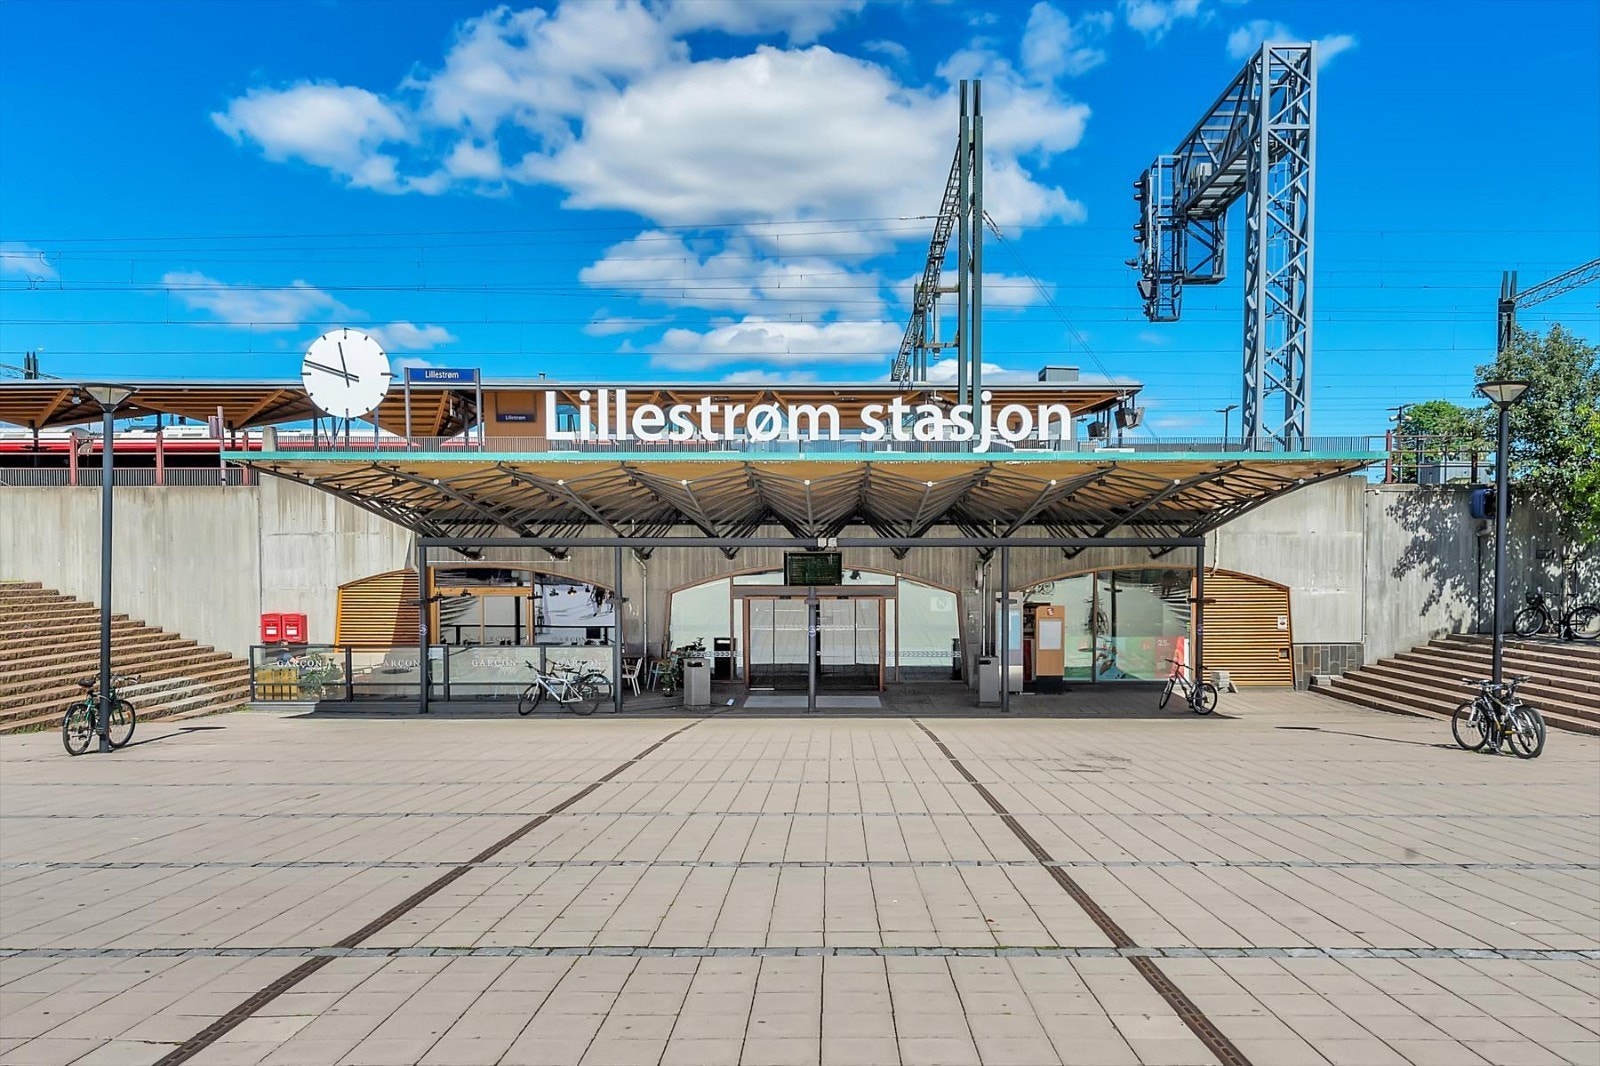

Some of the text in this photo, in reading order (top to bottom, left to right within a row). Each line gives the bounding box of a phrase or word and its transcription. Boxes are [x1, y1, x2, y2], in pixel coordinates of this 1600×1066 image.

[425, 370, 459, 379] Lillestrøm
[545, 389, 1072, 453] Lillestrøm stasjon
[376, 659, 421, 669] ARÇON
